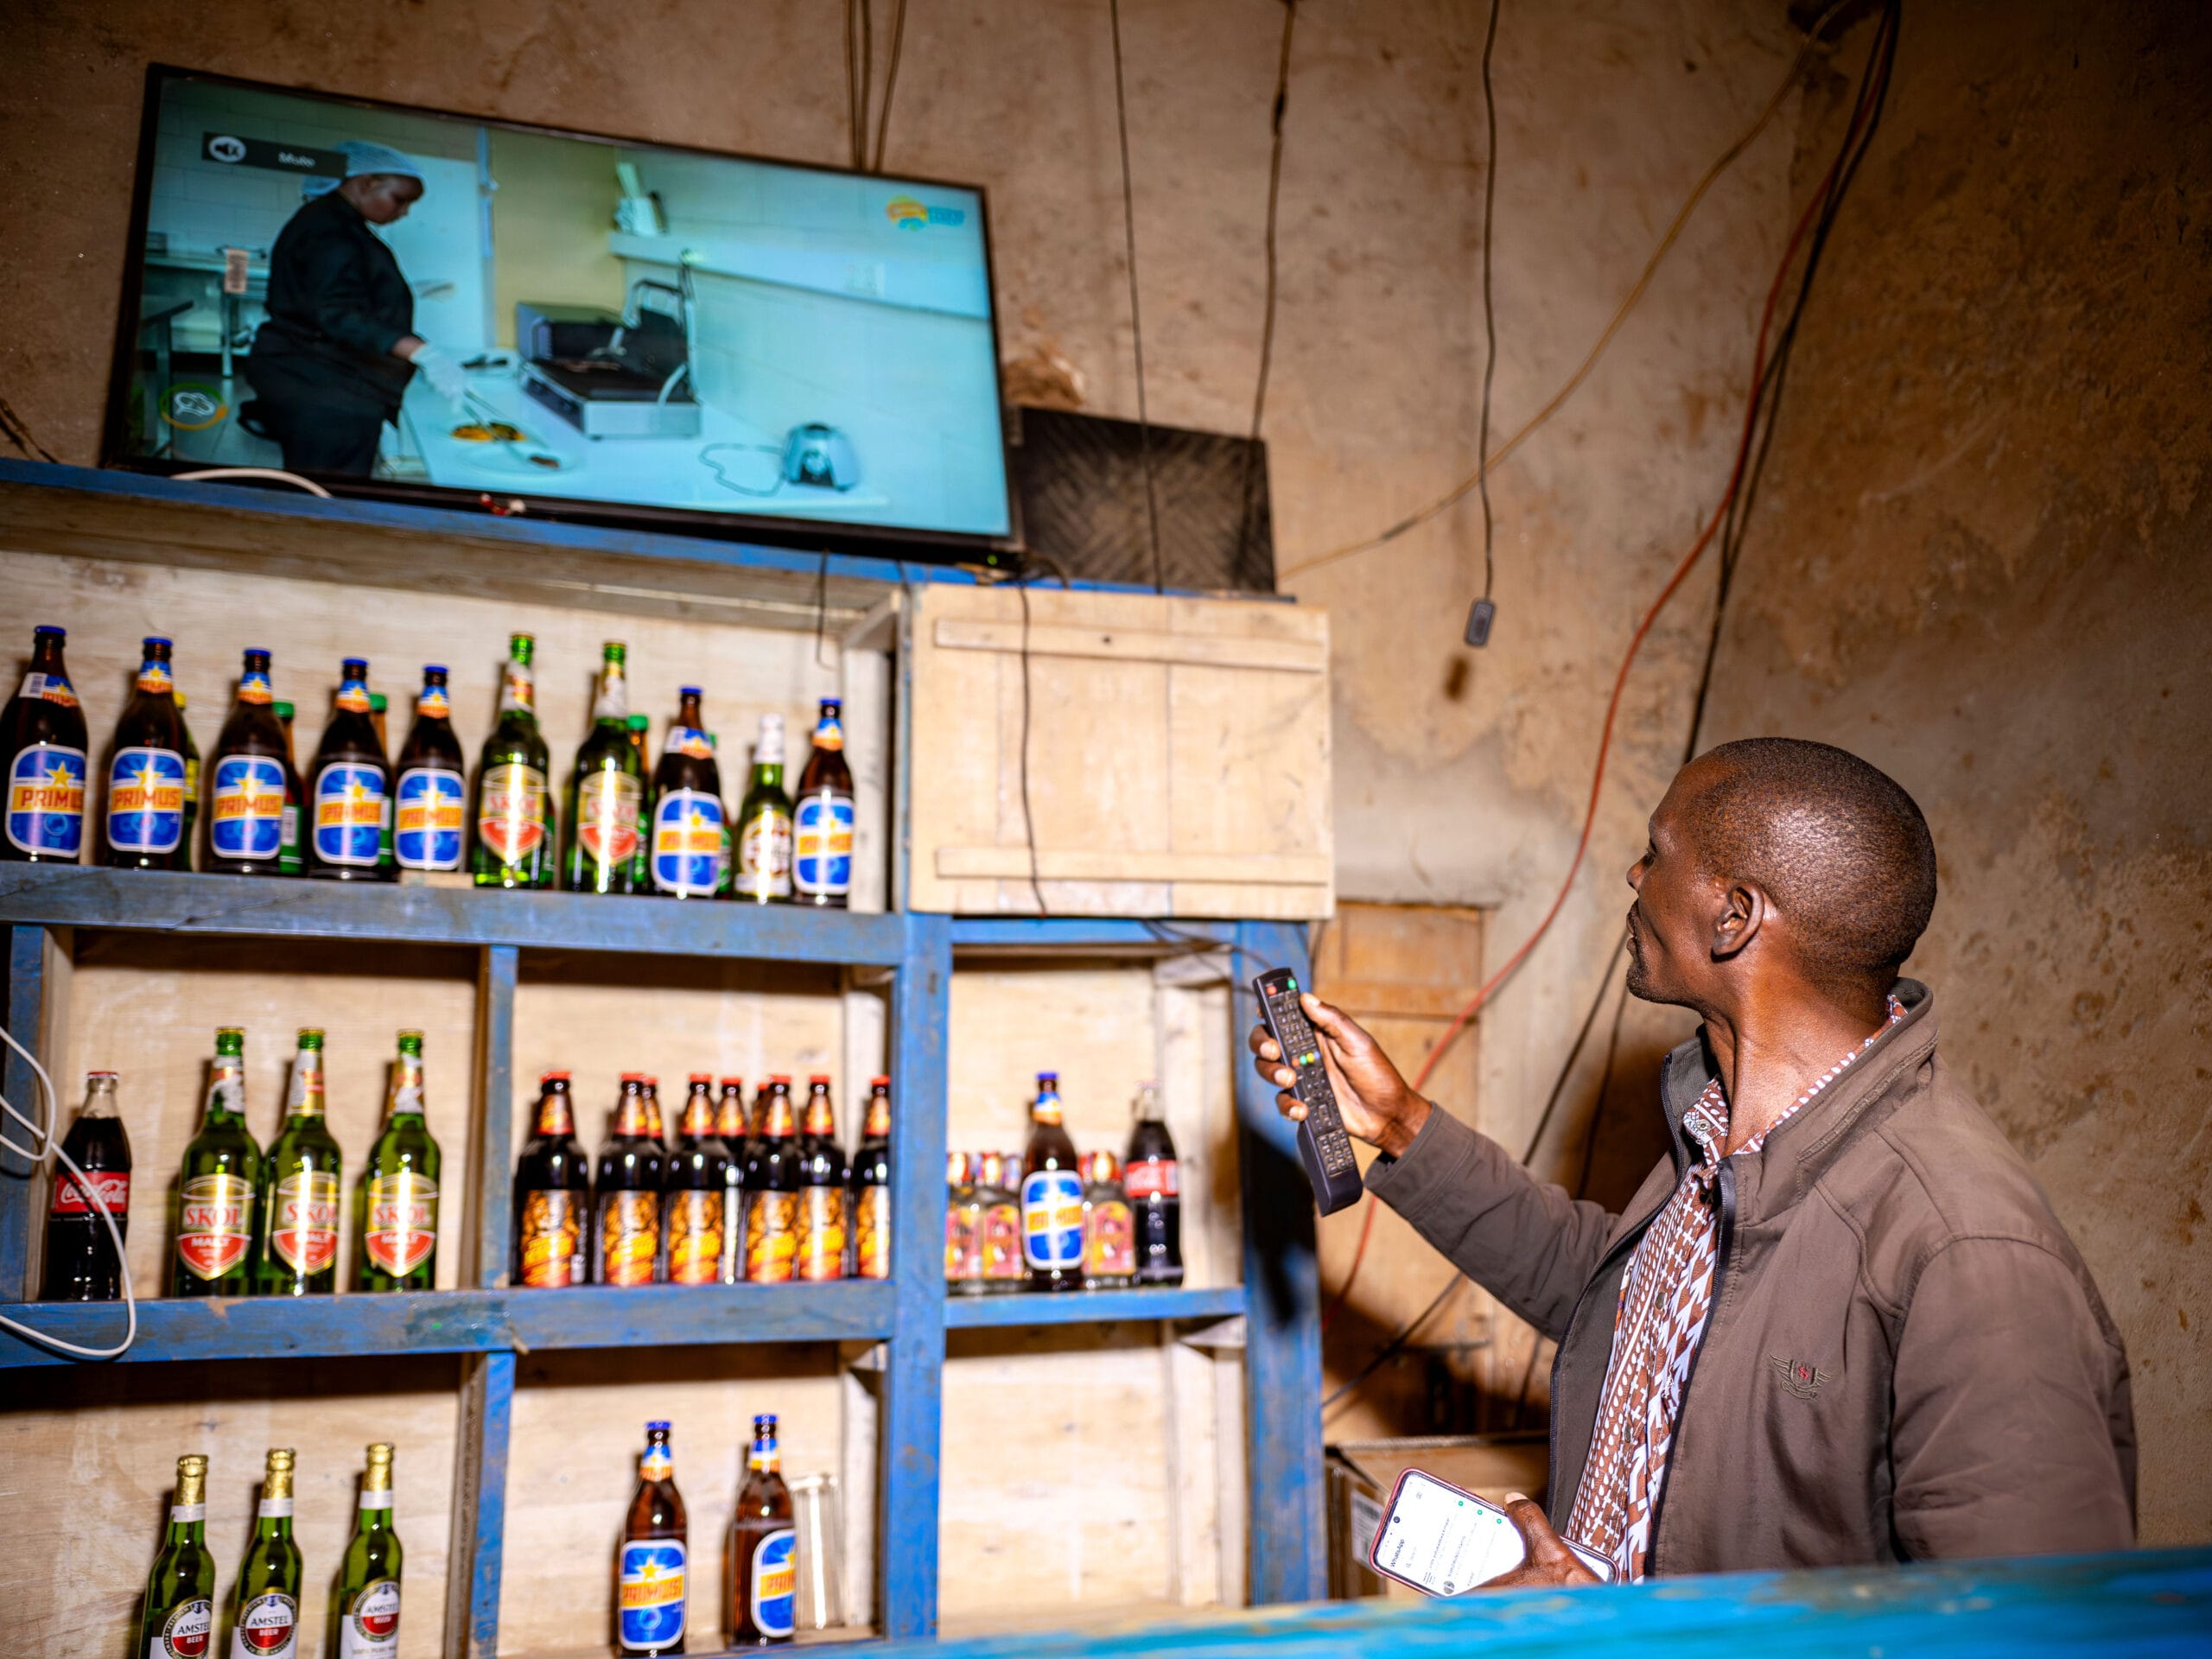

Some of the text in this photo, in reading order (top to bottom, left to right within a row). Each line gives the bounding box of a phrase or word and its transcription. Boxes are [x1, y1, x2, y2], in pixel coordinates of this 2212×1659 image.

[113, 790, 179, 808] PRIMUS
[186, 1205, 245, 1227] SKOL
[1390, 1539, 1405, 1567] WhatsApp
[250, 1615, 289, 1627] AMSTEL
